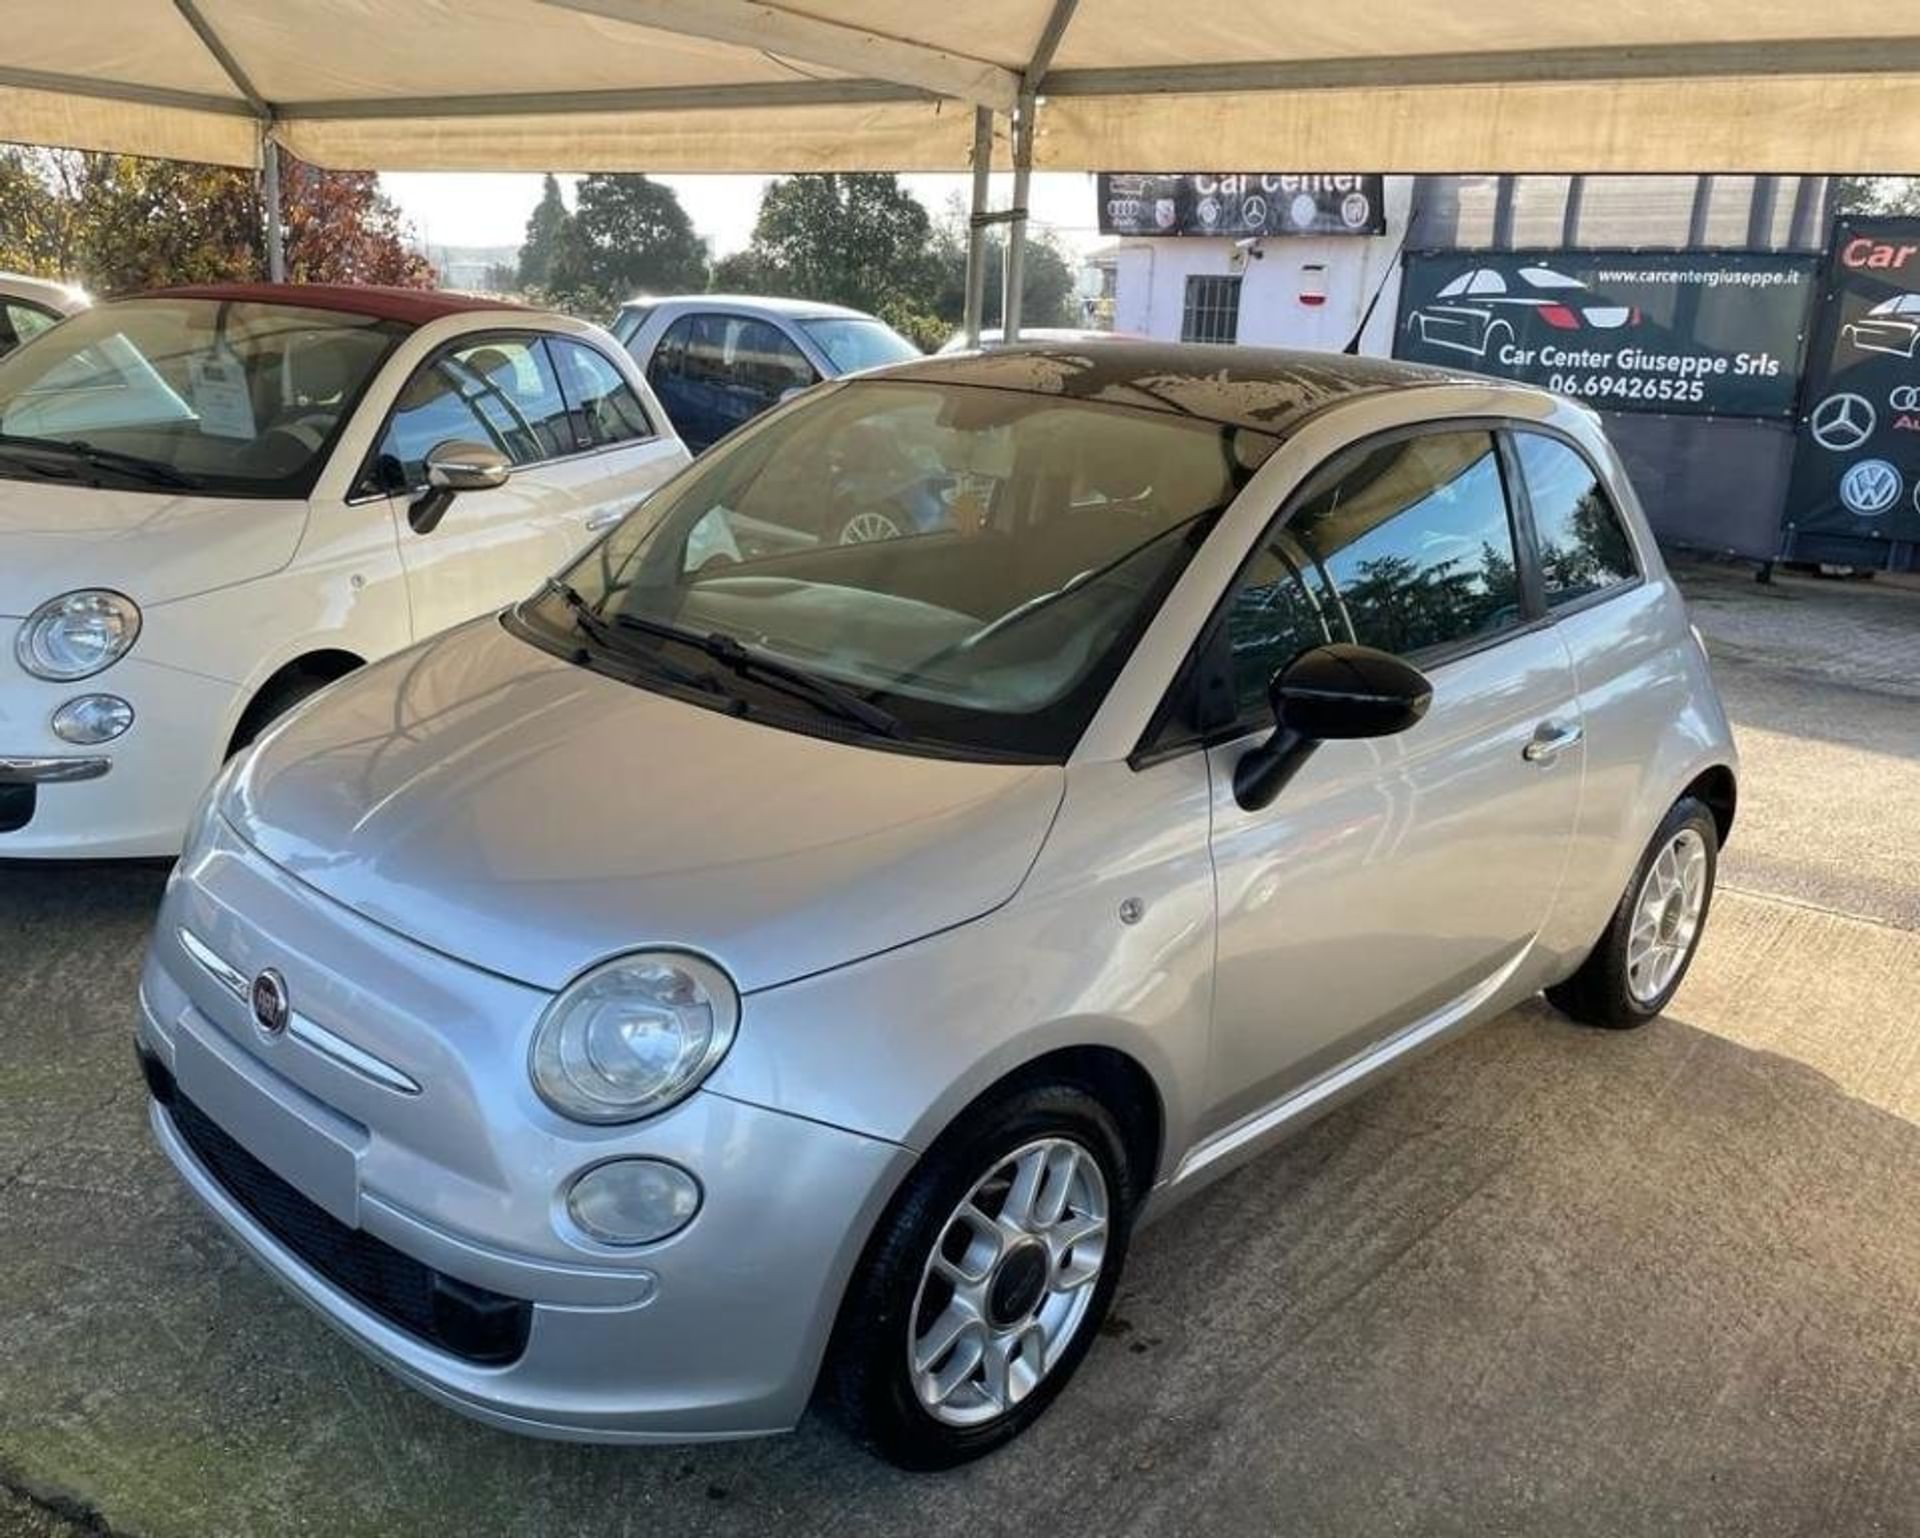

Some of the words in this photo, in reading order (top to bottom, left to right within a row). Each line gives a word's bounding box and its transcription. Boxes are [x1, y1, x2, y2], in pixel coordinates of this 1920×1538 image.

[1195, 174, 1245, 194] Car
[1843, 239, 1917, 268] Car
[1598, 269, 1799, 287] www.carcentergiuseppe.it
[1500, 345, 1535, 365] Car
[1540, 346, 1611, 367] Center
[1617, 349, 1727, 377] Giuseppe
[1734, 353, 1779, 376] Srls
[1549, 374, 1704, 401] 06.69426525
